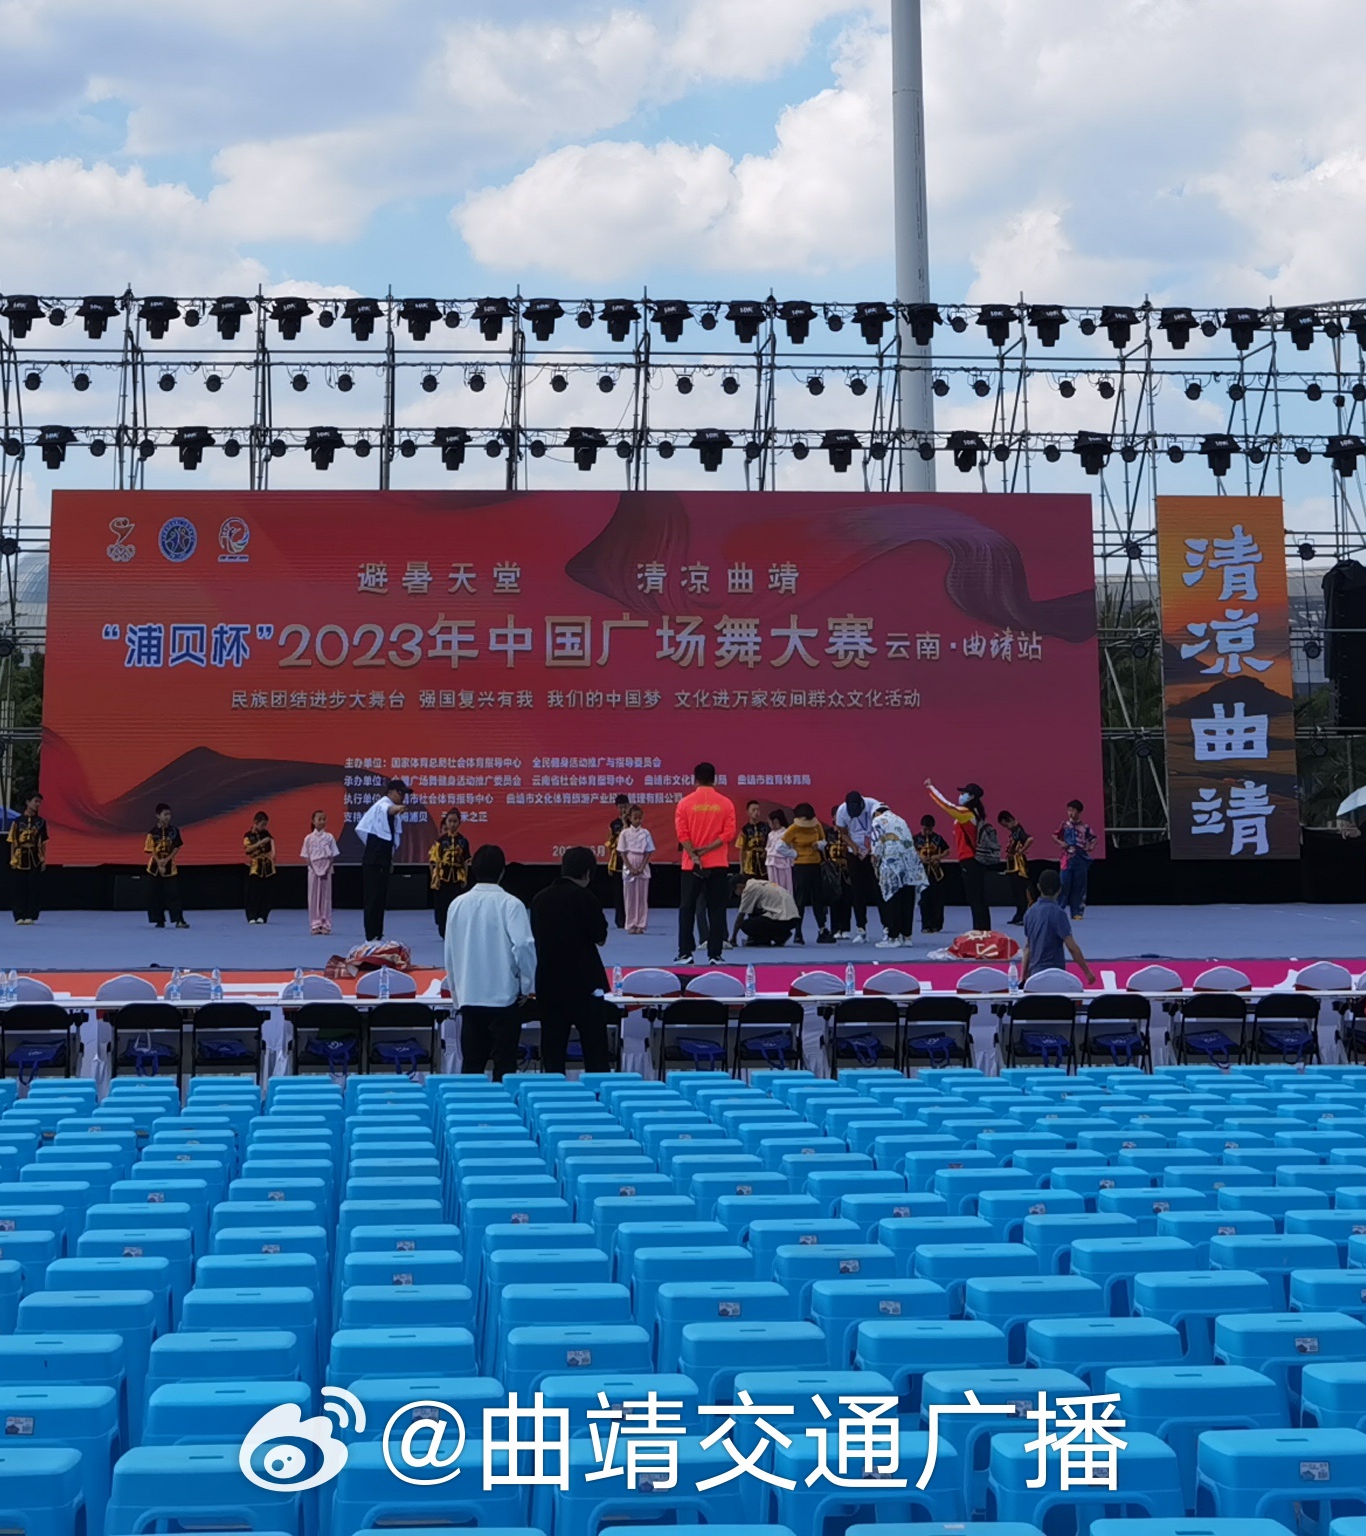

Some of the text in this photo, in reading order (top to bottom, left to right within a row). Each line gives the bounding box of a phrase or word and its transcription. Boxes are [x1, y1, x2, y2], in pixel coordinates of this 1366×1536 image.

[356, 561, 800, 595] 避暑天堂 清凉曲靖
[230, 689, 407, 710] 民族团结进步大舞台
[419, 689, 534, 710] 强国复兴有我
[547, 688, 663, 710] 我们的中国梦
[1181, 524, 1276, 856] 清凉曲靖
